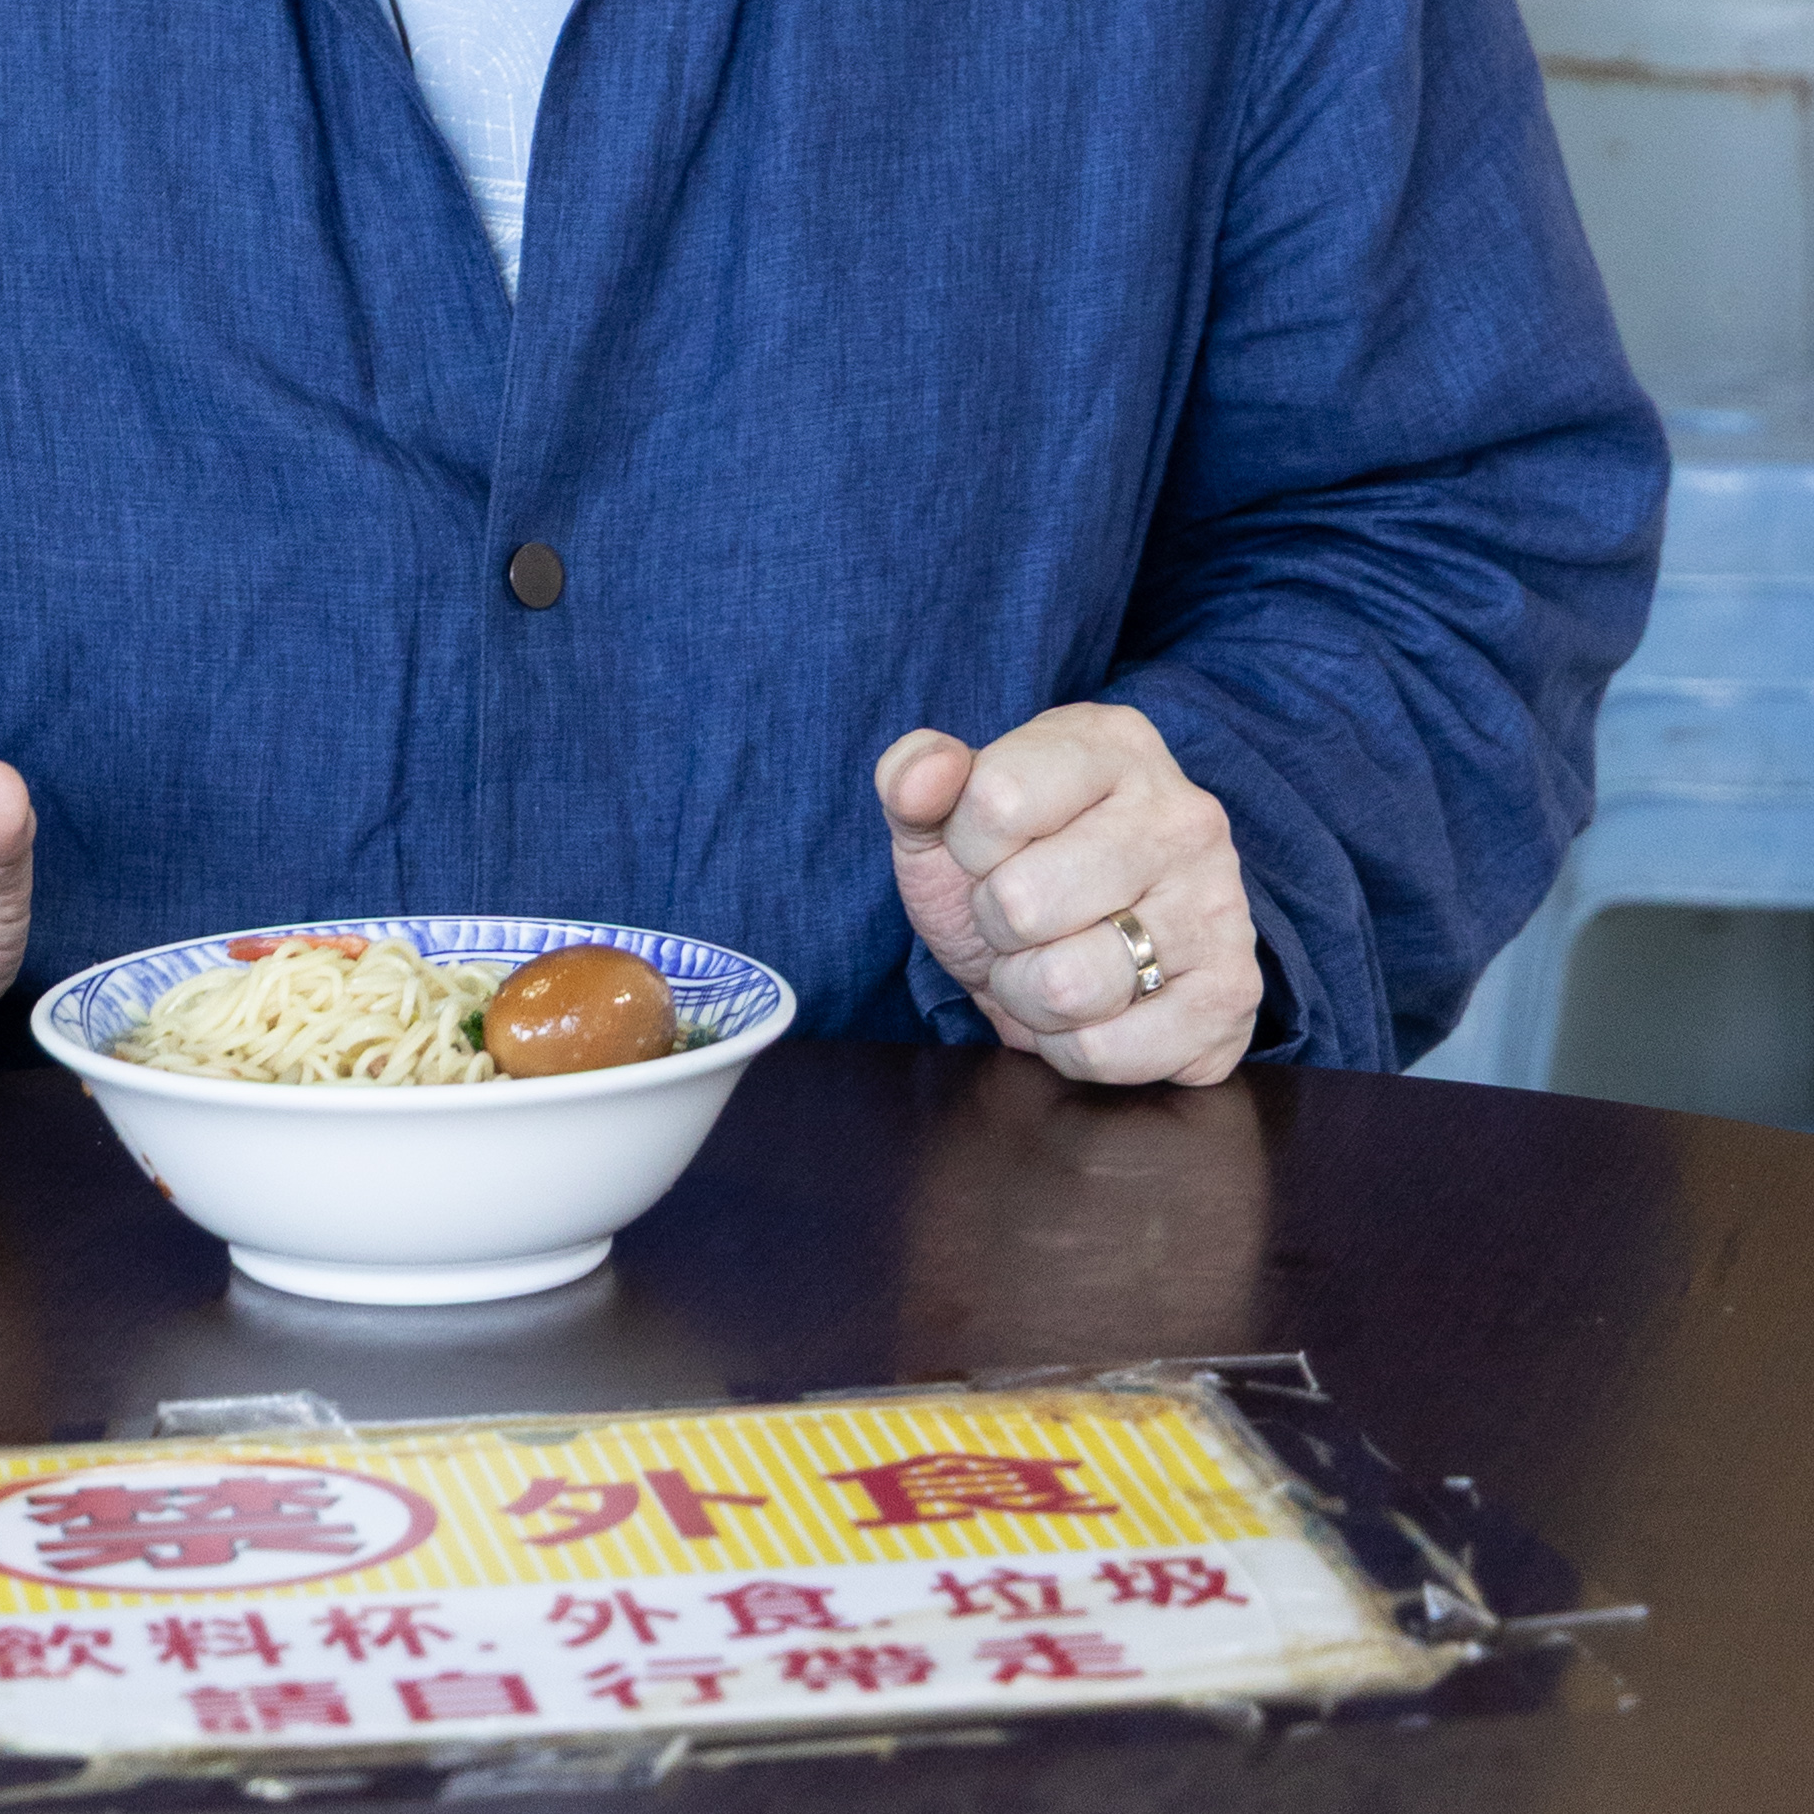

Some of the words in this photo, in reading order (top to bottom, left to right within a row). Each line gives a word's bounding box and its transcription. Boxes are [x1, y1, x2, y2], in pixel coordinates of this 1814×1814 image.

[24, 1476, 366, 1572] 禁
[502, 1451, 1122, 1547] 外食
[183, 1630, 1144, 1734] 請自行帶走
